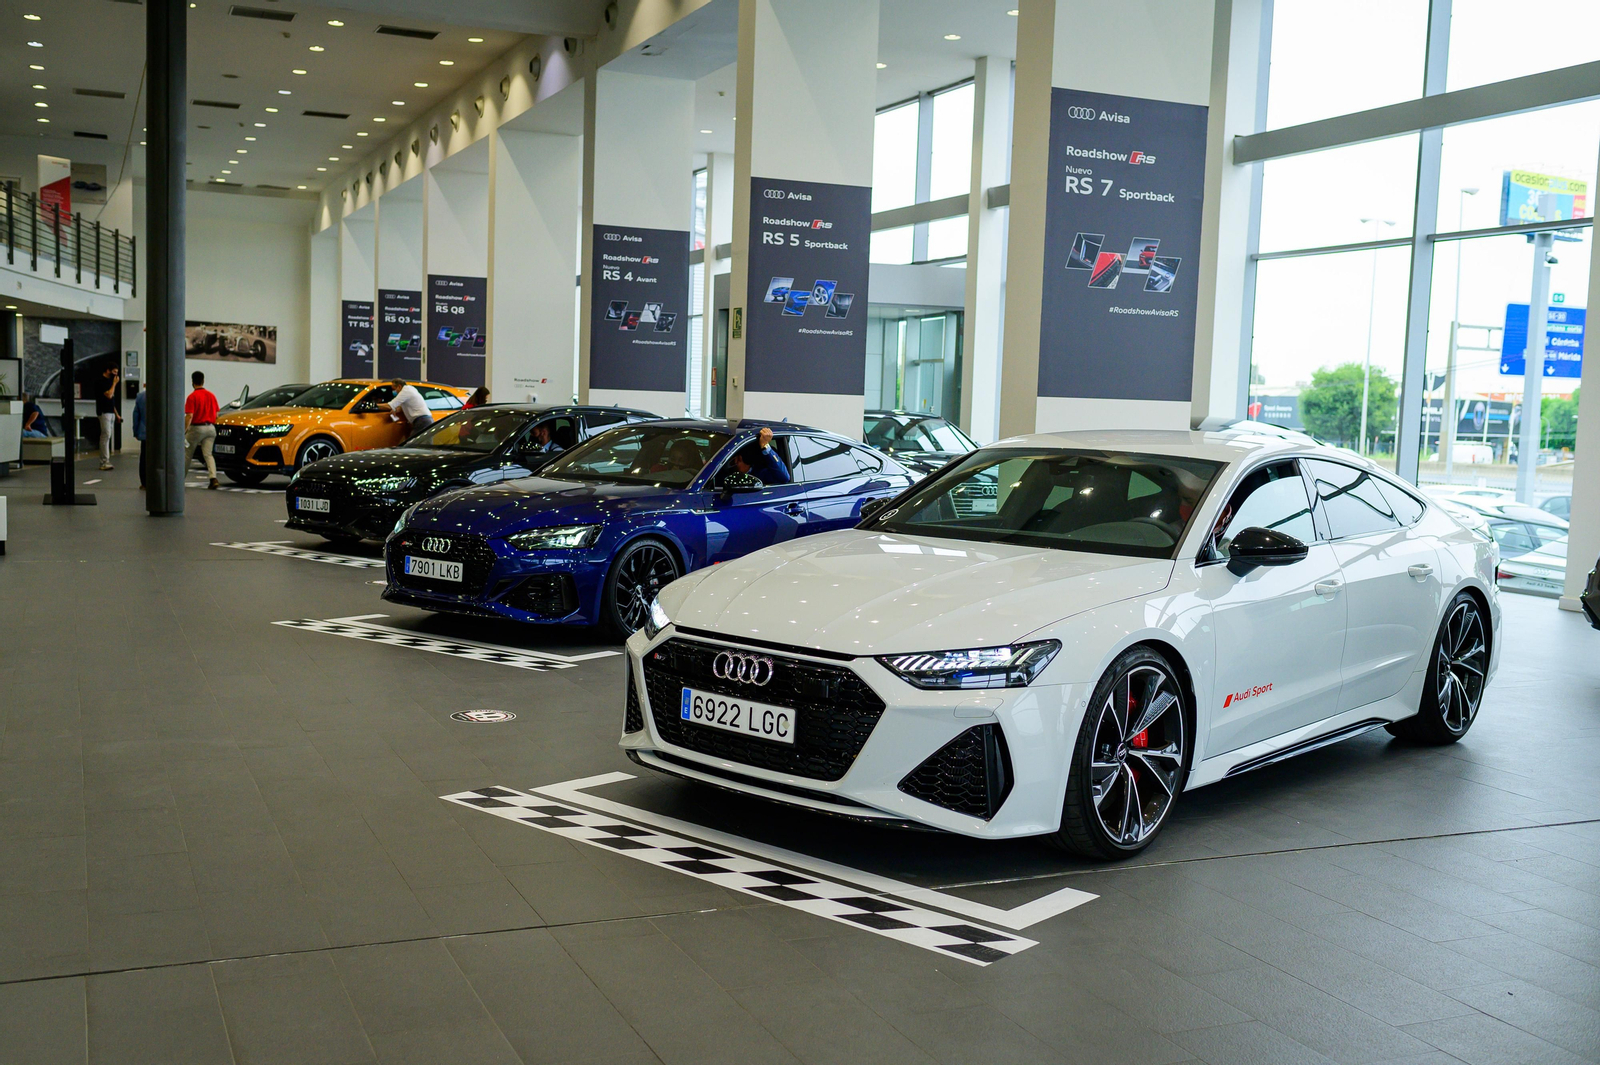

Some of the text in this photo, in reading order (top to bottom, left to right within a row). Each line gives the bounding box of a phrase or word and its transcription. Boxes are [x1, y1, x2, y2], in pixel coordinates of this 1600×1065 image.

[1099, 110, 1130, 124] Avisa
[1066, 146, 1128, 162] Roadshow
[1065, 165, 1093, 176] Nuevo
[1065, 176, 1175, 202] RS 7 Sportback
[788, 192, 812, 202] Avisa
[762, 216, 810, 228] Roadshow
[762, 232, 848, 250] RS 5 Sportback
[602, 254, 642, 262] Roadshow
[602, 270, 620, 280] RS
[624, 272, 633, 282] 4
[450, 306, 465, 314] Q8
[1108, 306, 1180, 318] #RoadshowAvisaRS
[411, 560, 460, 579] 7901 LKB
[1233, 682, 1273, 702] Audi Sport
[693, 696, 741, 728] 6922
[748, 707, 788, 738] LGC
